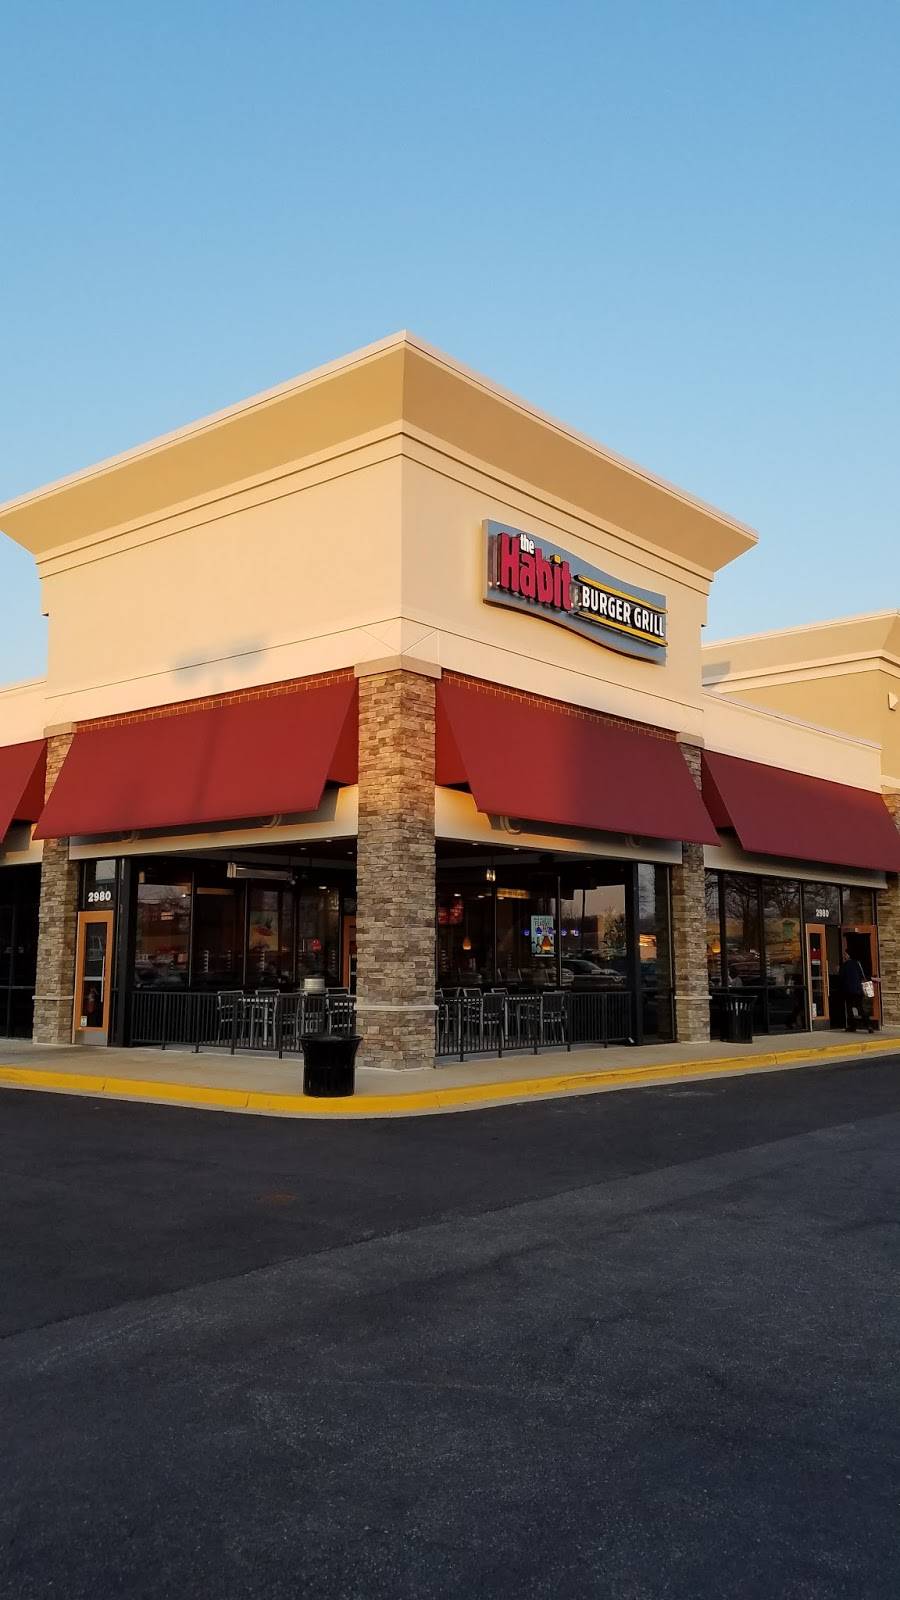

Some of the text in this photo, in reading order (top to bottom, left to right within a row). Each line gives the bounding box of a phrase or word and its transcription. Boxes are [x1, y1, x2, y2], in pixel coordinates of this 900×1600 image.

[519, 533, 535, 554] the
[499, 532, 571, 610] Habit
[582, 585, 664, 637] BURGER GRILL
[88, 890, 111, 902] 2980
[815, 908, 829, 917] 2980
